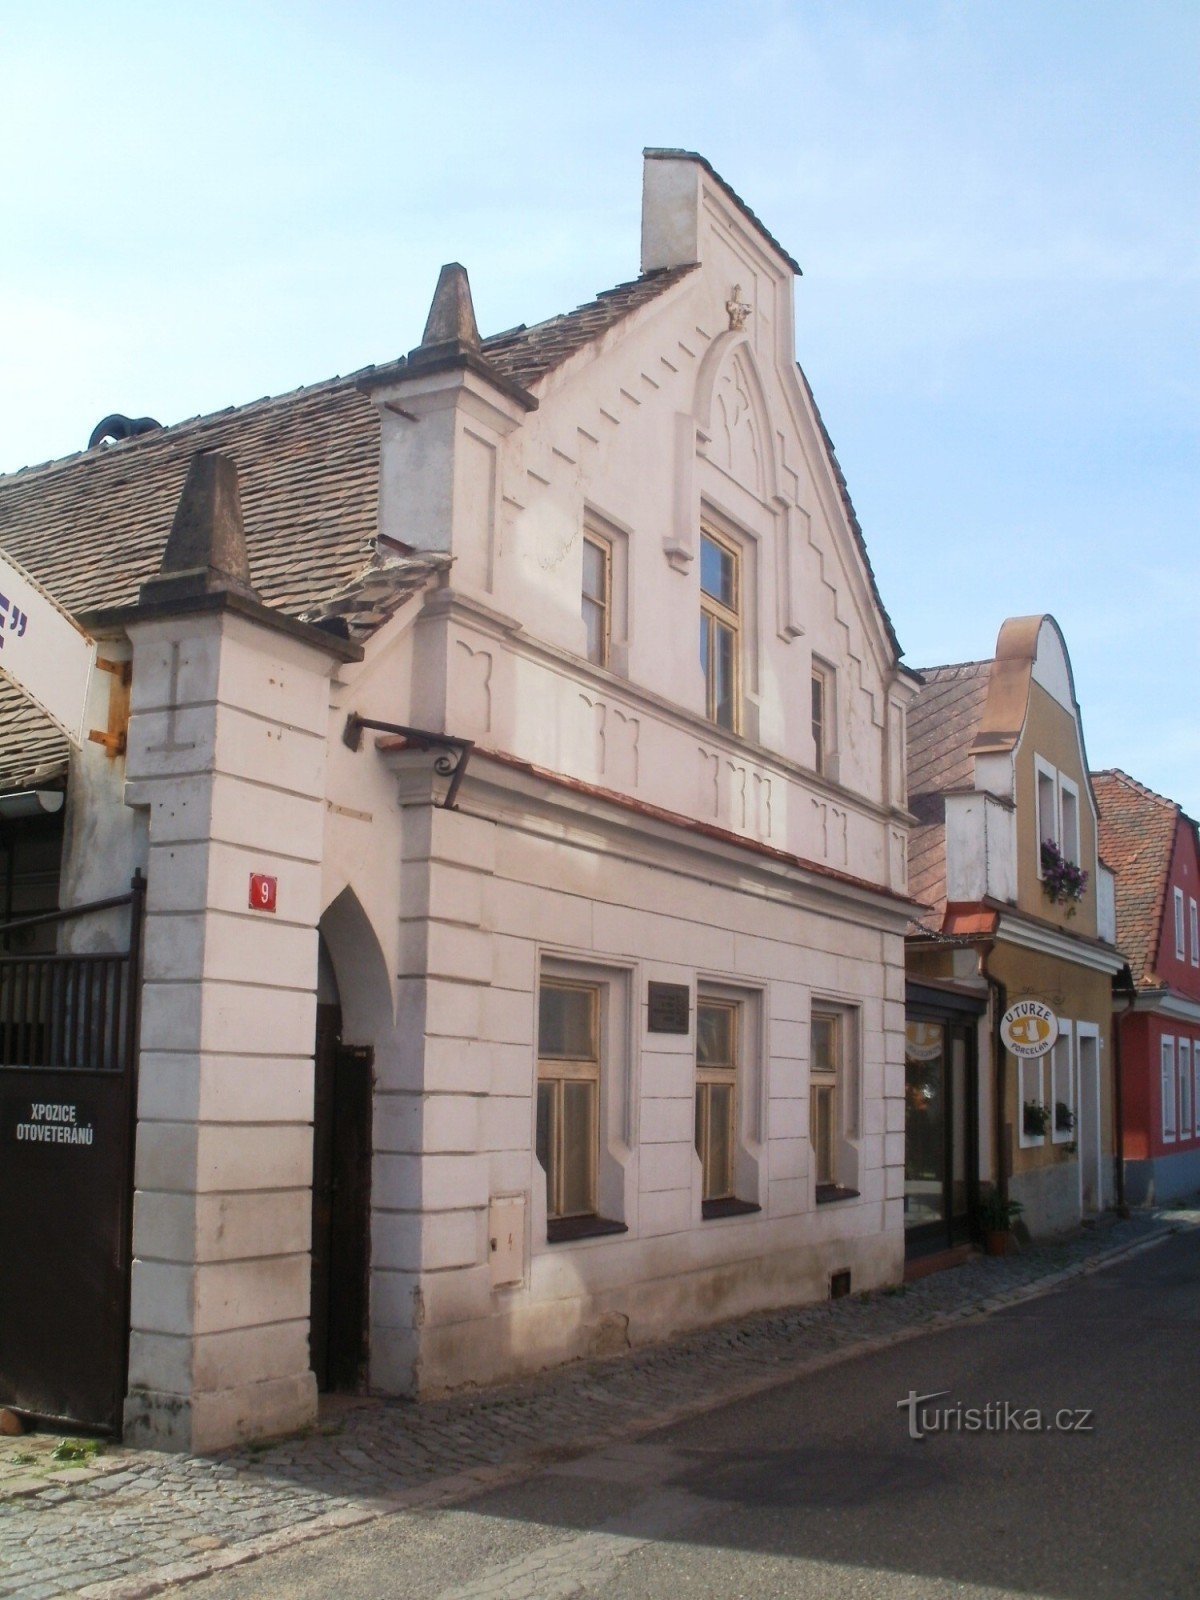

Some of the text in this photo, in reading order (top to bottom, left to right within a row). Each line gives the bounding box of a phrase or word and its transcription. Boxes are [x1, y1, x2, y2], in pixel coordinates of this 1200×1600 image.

[260, 882, 269, 904] 9
[1005, 1003, 1052, 1023] U TVRZE
[31, 1103, 76, 1122] XPOZICE
[16, 1122, 93, 1145] OTOVETERÁNŮ
